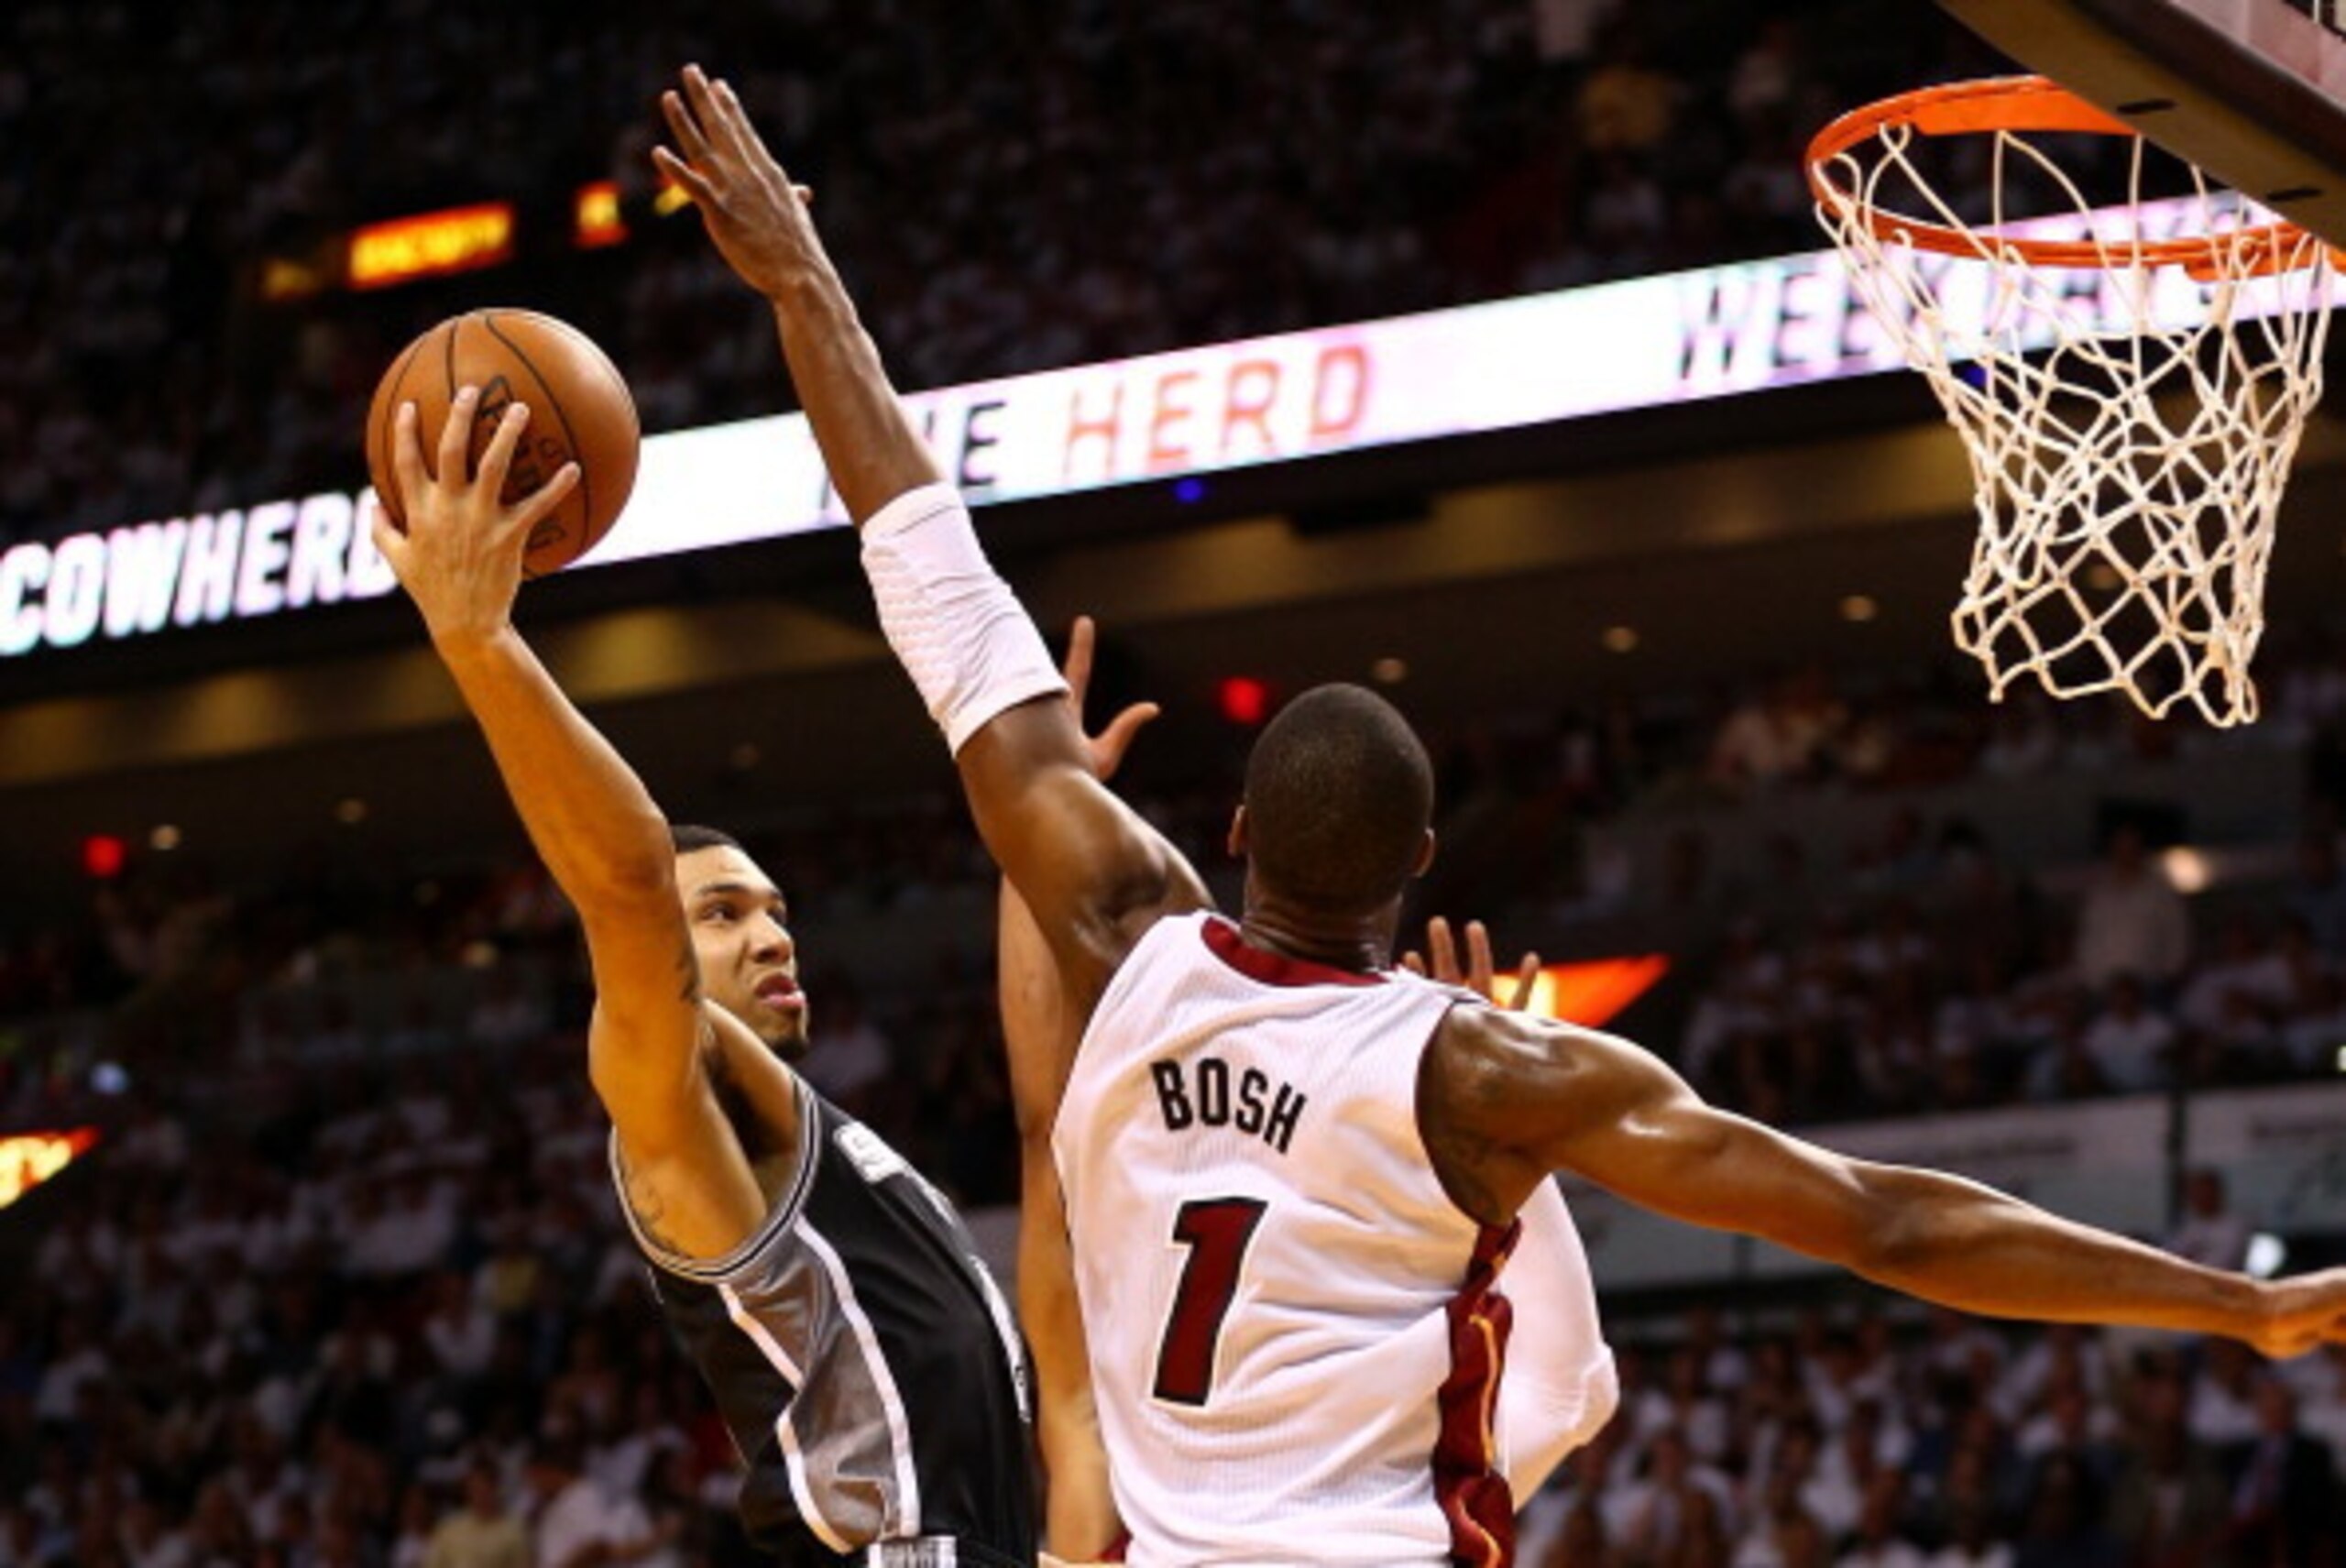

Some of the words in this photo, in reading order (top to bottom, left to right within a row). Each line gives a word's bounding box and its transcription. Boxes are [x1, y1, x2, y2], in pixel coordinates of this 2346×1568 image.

[1063, 343, 1368, 483] HERD
[1151, 1058, 1308, 1155] BOSH
[1152, 1196, 1269, 1407] 1
